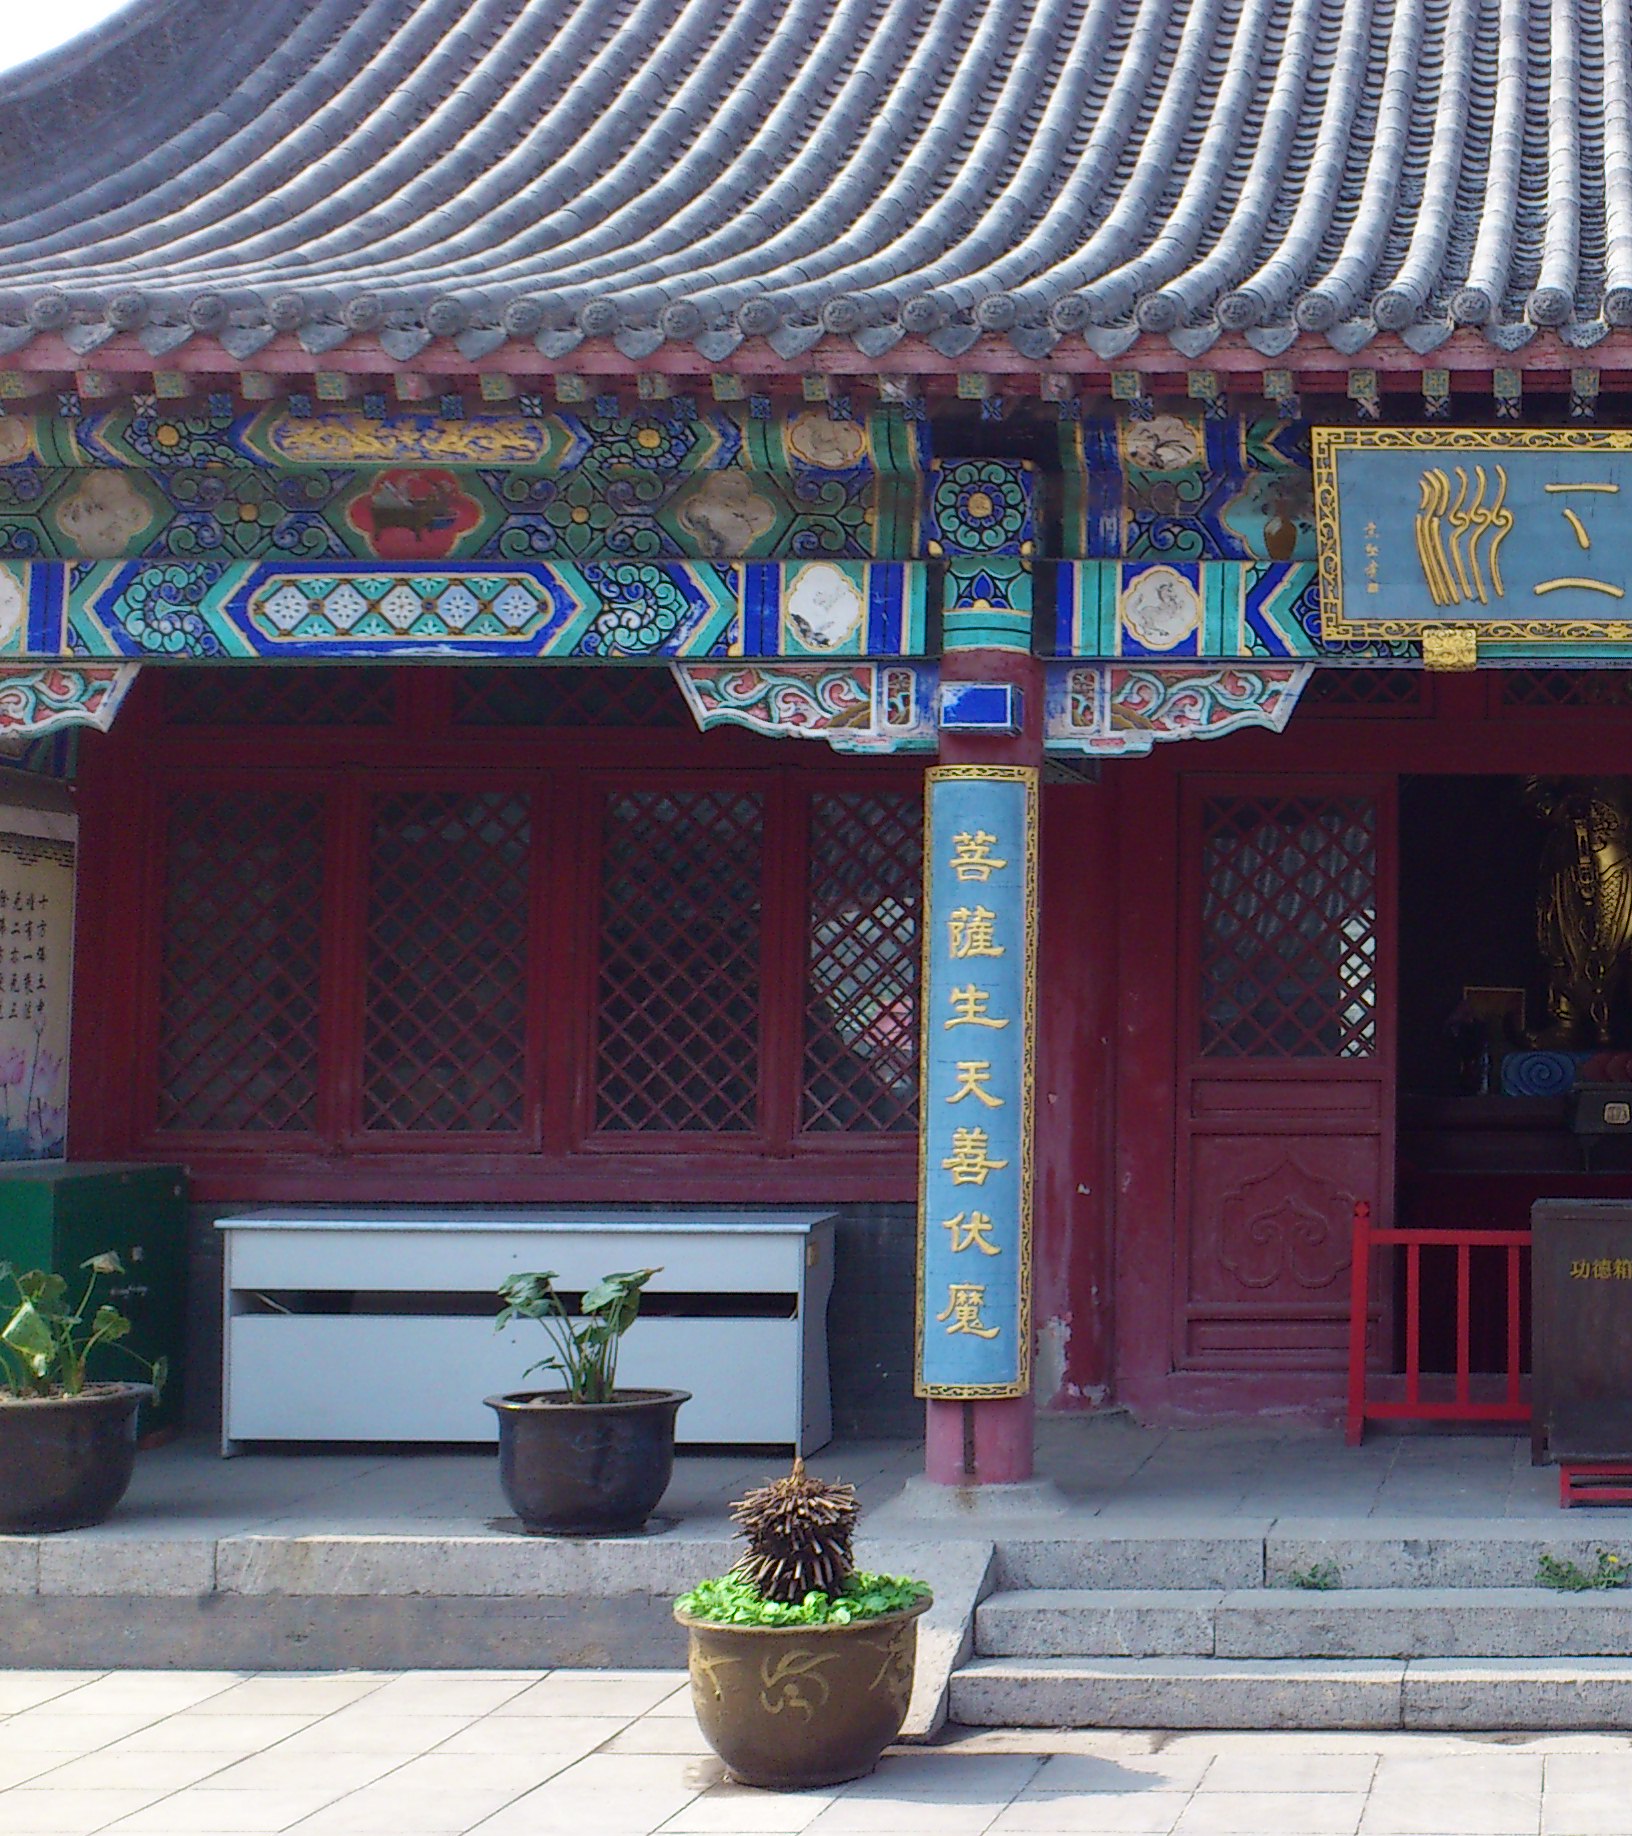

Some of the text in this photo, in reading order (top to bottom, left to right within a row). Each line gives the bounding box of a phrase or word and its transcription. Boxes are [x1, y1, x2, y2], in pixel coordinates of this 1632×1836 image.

[937, 830, 1009, 1338] 菩薩生天善伏魔
